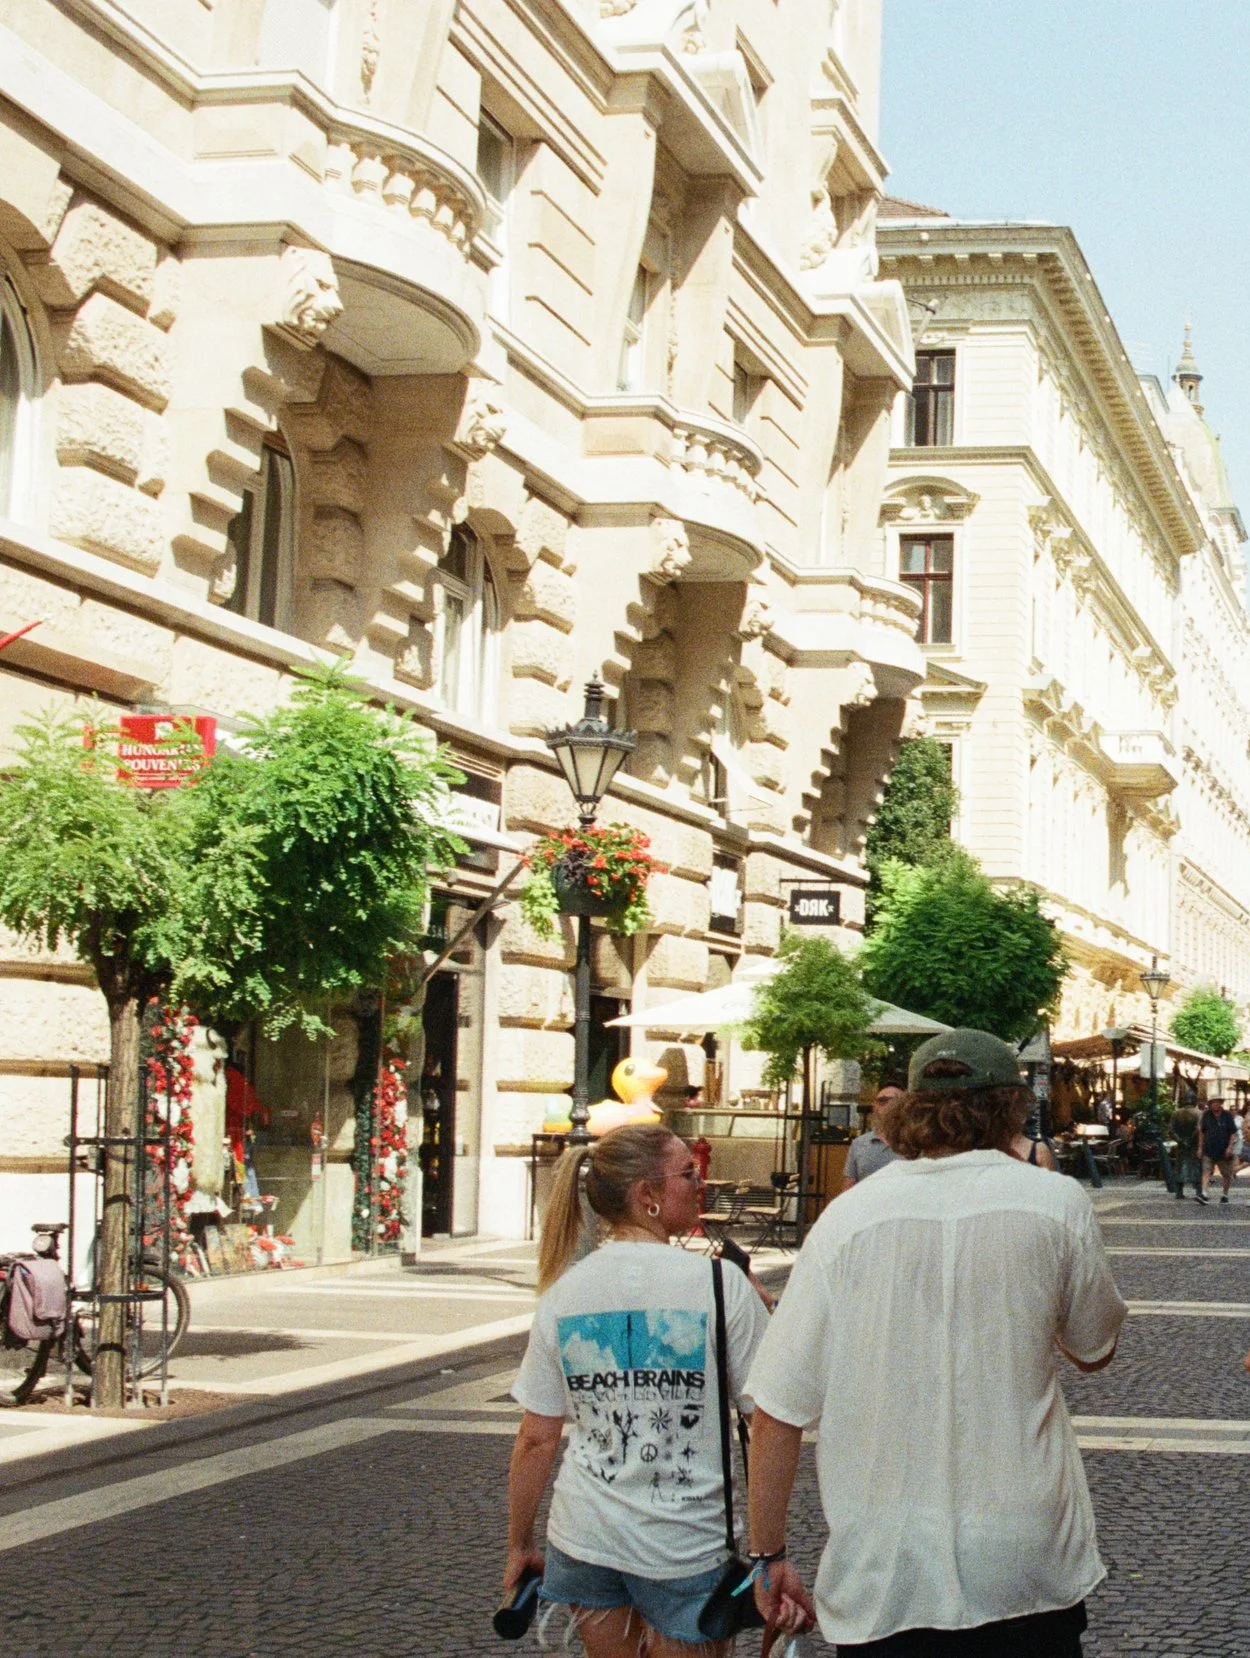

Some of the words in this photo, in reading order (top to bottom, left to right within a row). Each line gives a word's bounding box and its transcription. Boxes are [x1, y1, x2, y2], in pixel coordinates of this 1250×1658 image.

[122, 743, 201, 756] HUNGAR
[122, 758, 201, 771] OUVENS
[567, 1370, 630, 1391] BEACH
[633, 1369, 706, 1390] BRAINS
